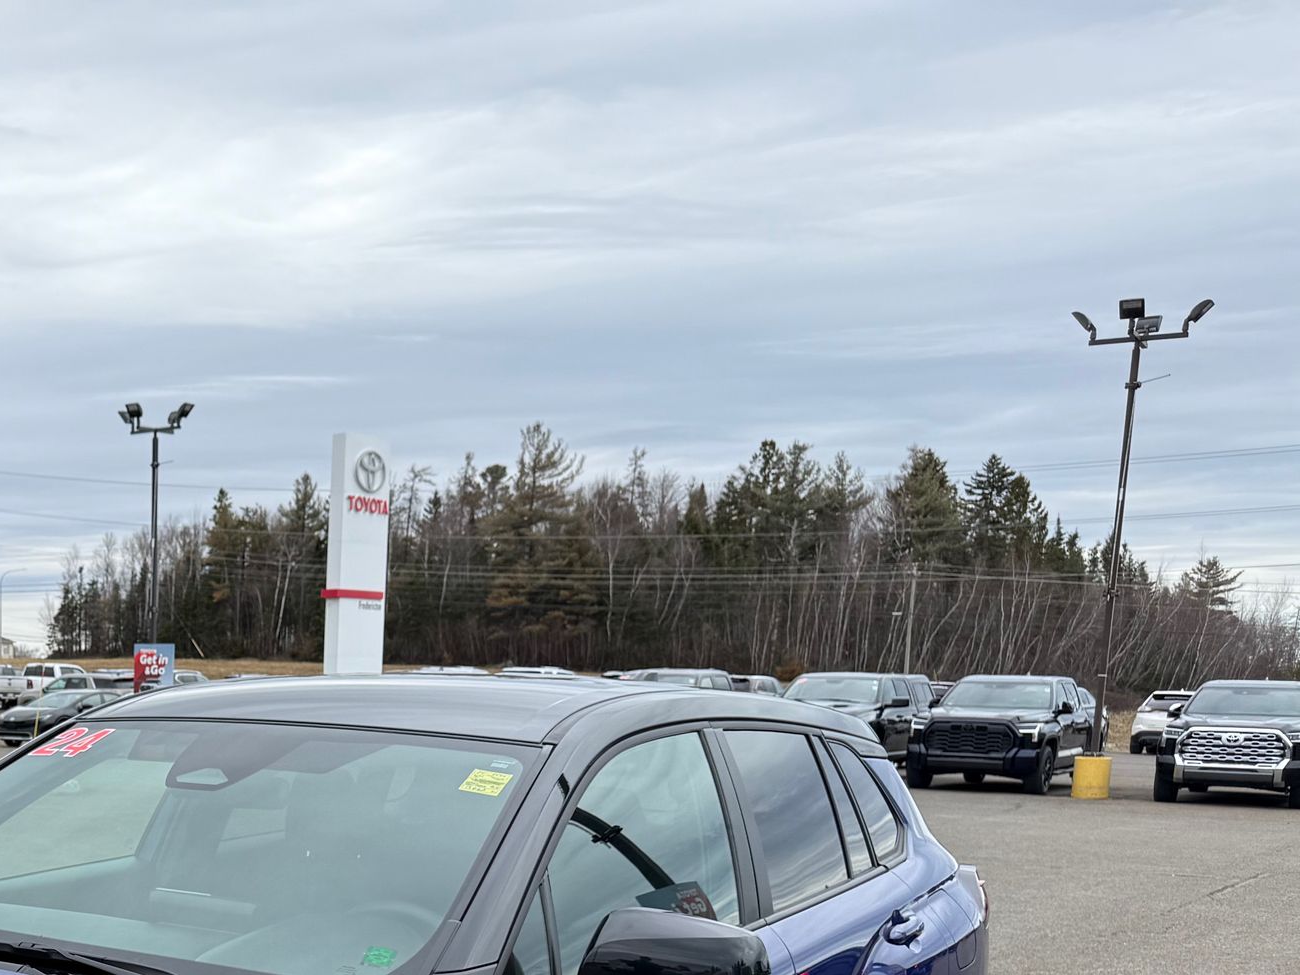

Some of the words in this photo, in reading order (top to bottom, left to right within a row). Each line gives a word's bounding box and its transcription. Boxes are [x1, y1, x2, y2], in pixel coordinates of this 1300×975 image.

[347, 495, 389, 515] TOYOTA
[140, 654, 157, 665] Get
[158, 653, 169, 665] in
[27, 727, 117, 758] 24
